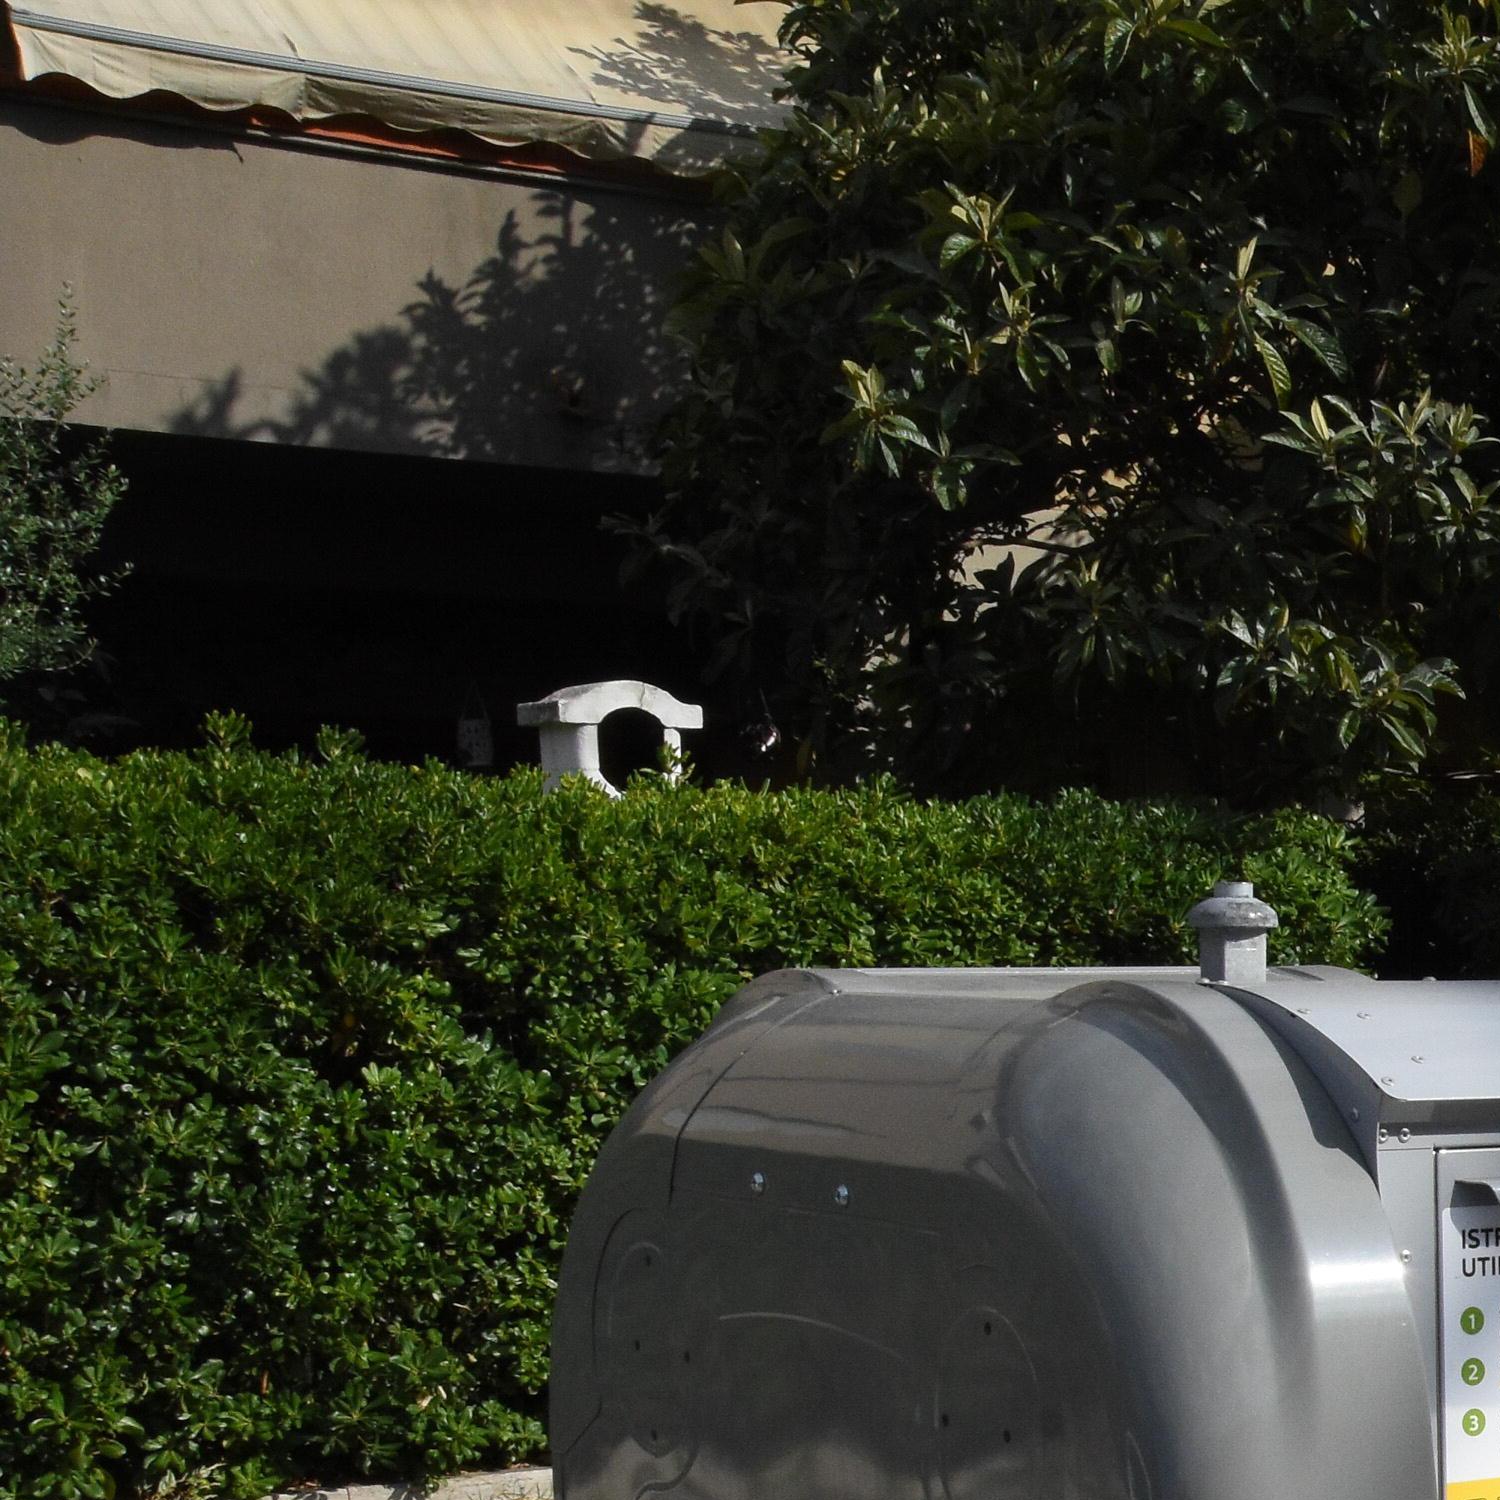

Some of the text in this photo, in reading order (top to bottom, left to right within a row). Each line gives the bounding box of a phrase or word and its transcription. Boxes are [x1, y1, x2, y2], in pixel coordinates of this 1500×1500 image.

[1468, 1314, 1476, 1327] 1
[1468, 1364, 1478, 1379] 2
[1470, 1415, 1478, 1429] 3
